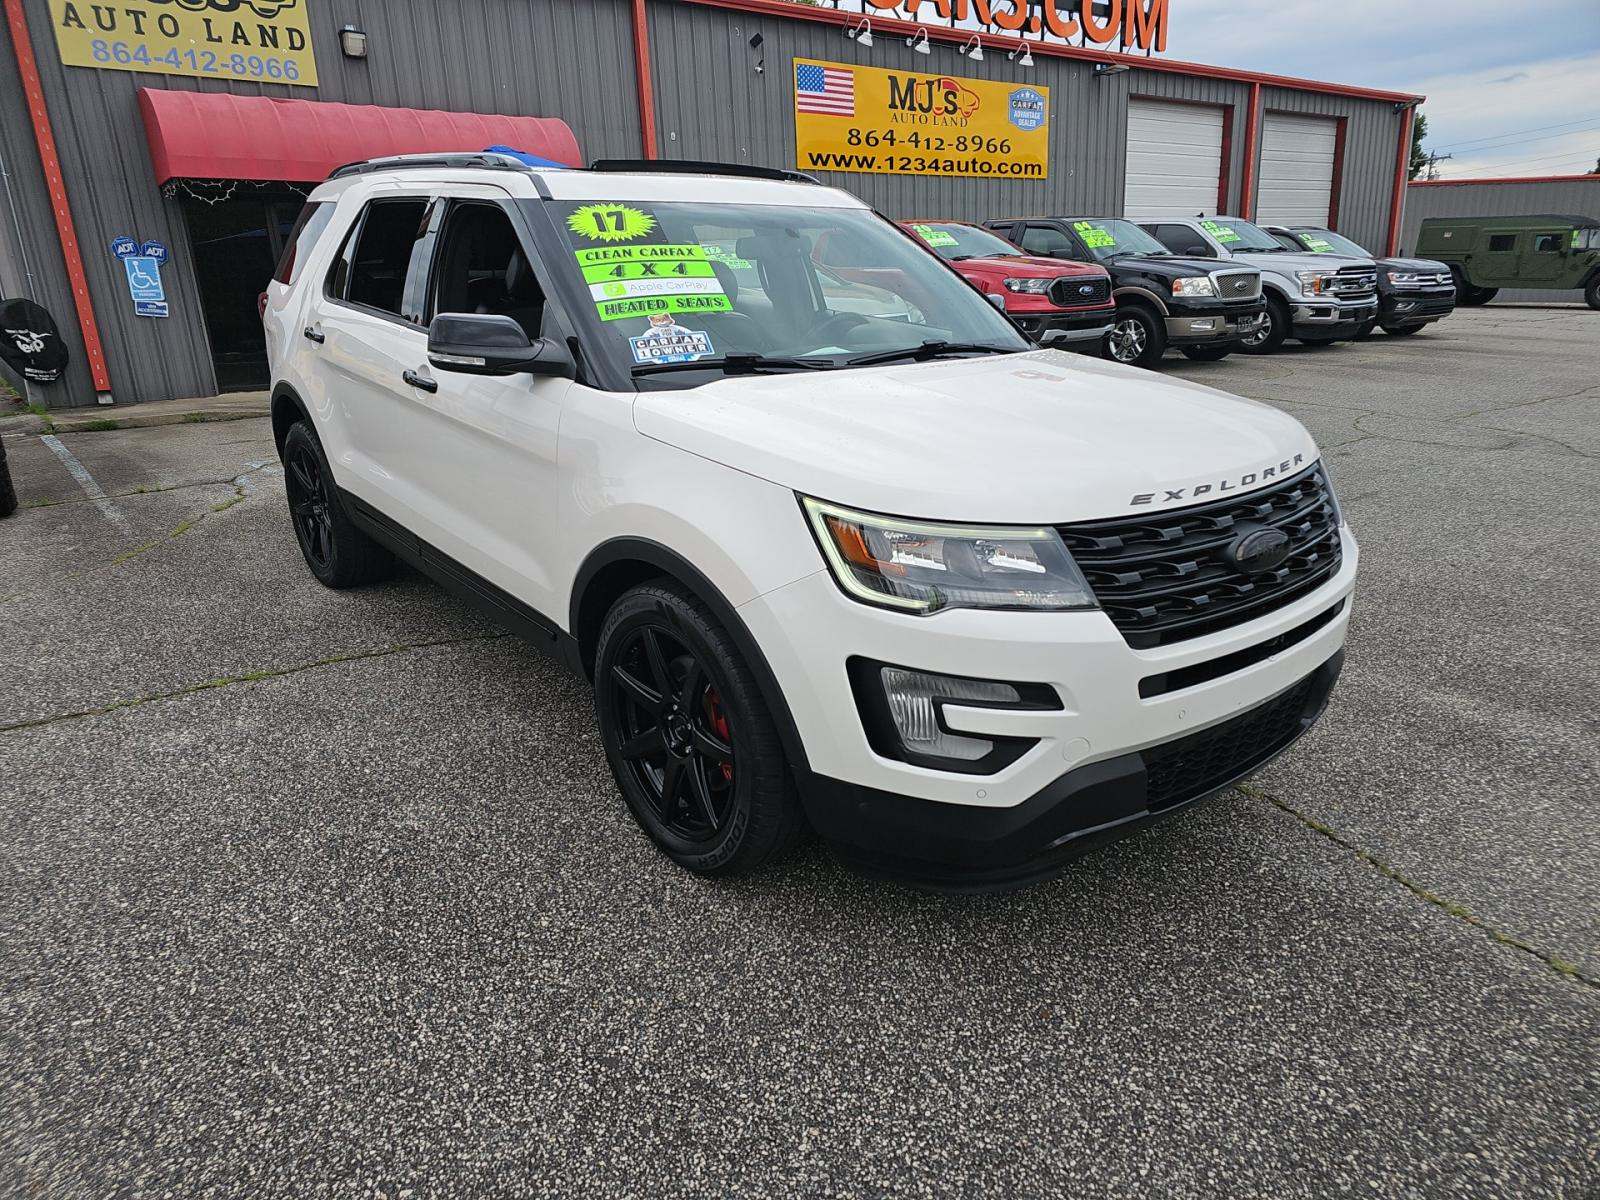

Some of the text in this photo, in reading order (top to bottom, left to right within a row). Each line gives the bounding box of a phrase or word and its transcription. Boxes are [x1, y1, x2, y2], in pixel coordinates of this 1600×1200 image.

[62, 1, 306, 51] AUTO LAND
[862, 0, 1170, 53] .COM
[90, 39, 300, 81] 864-412-8966
[890, 112, 969, 128] AUTO LAND
[846, 128, 1012, 154] 864-412-8966
[807, 151, 1043, 176] www.1234auto.com
[592, 210, 627, 233] 17
[118, 243, 134, 254] ADT
[146, 247, 164, 257] ADT
[584, 246, 696, 262] CLEAN CARFAX
[609, 262, 688, 278] 4 X 4
[630, 280, 708, 293] Apple CarPlay
[604, 296, 725, 316] HEATED SEATS
[636, 334, 704, 348] CARFAX
[651, 344, 707, 356] OWNER
[1129, 453, 1303, 506] EXPLORER
